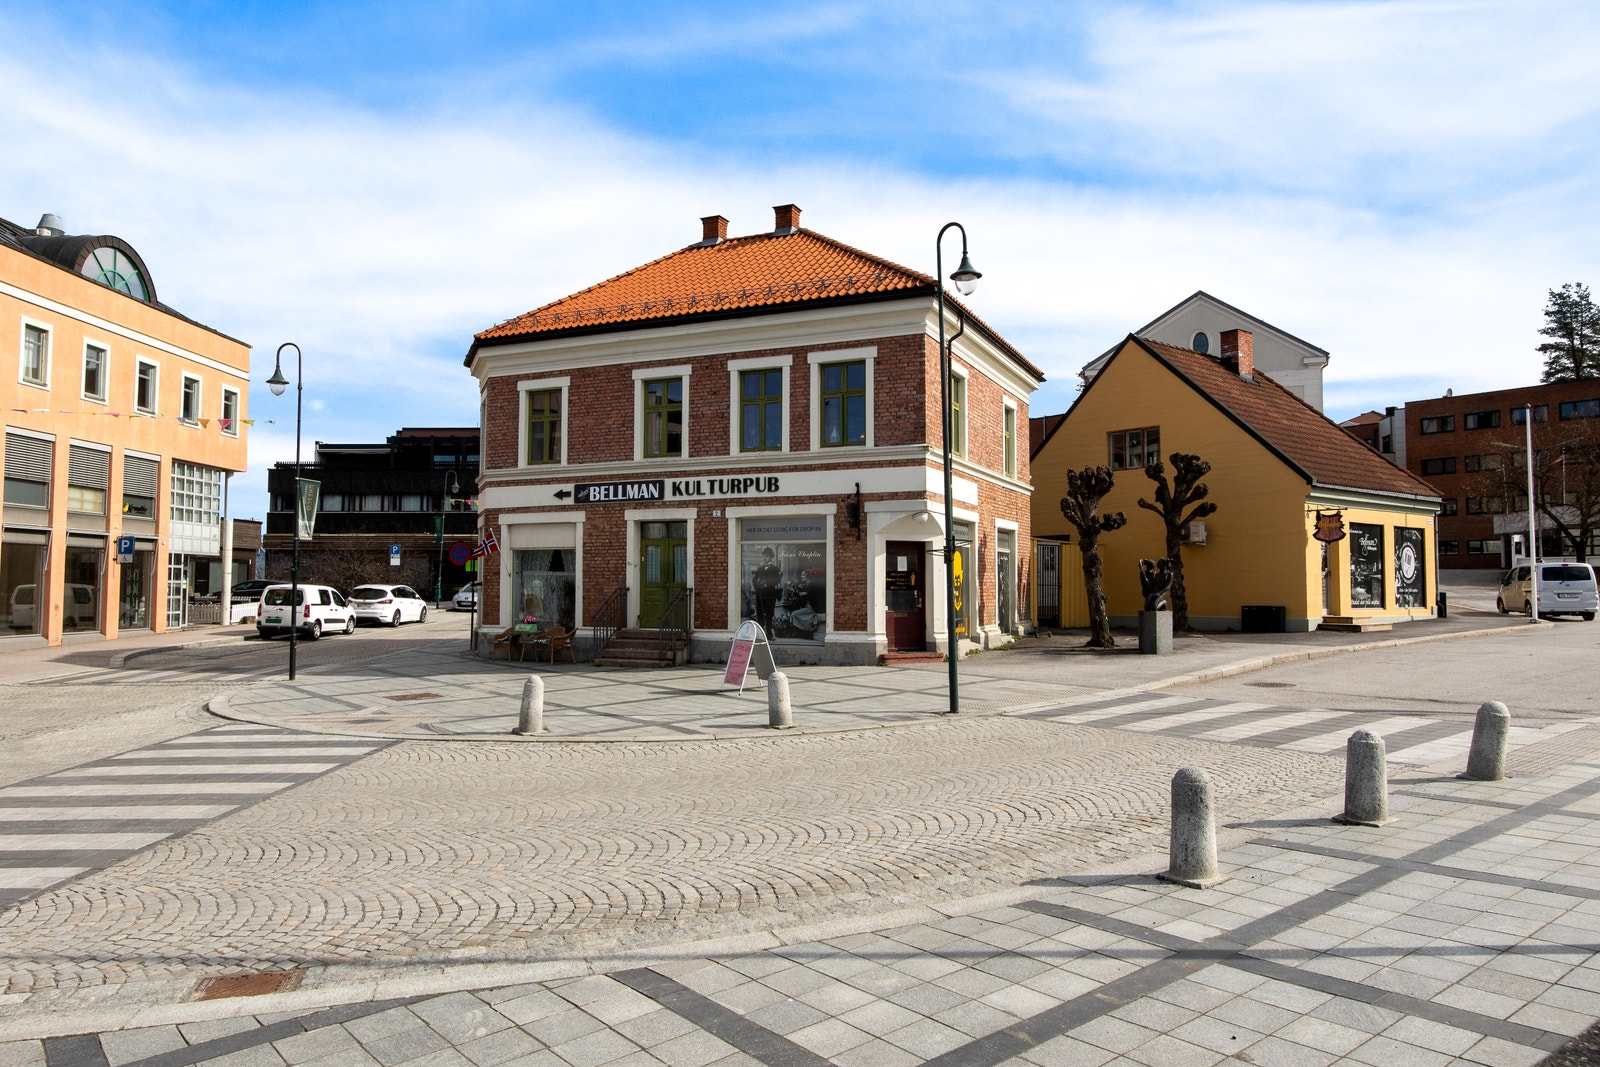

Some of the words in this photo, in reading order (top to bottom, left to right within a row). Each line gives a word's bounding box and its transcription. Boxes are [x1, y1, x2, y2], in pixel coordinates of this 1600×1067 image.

[306, 484, 314, 511] UNESCO
[589, 483, 660, 502] BELLMAN
[671, 476, 780, 497] KULTURPUB
[121, 540, 130, 552] P
[797, 550, 821, 560] Chaplin
